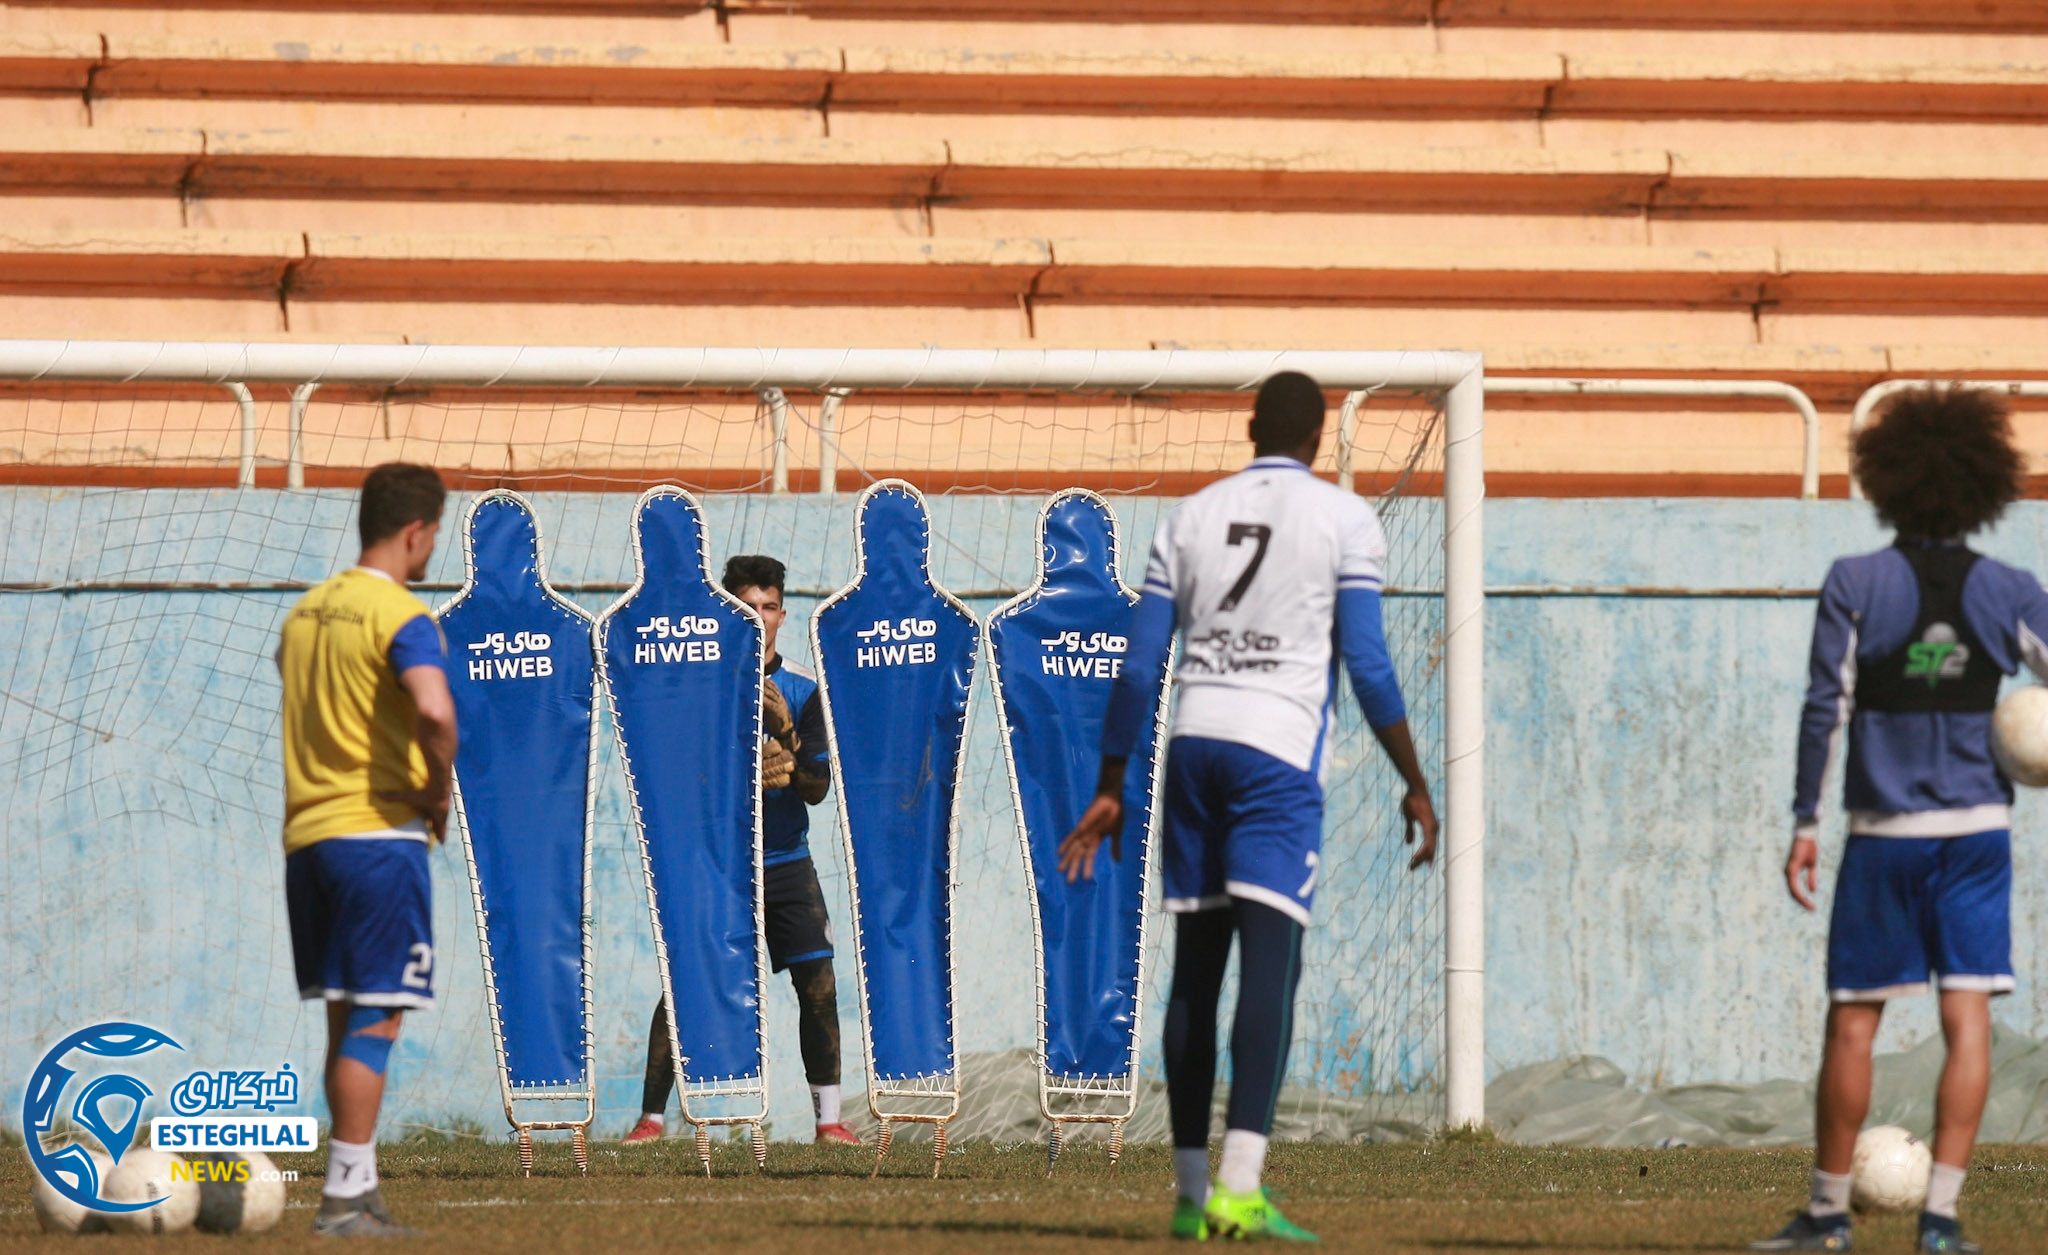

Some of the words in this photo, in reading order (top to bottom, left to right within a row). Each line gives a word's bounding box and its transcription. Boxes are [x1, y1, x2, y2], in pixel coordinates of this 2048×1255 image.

[1218, 522, 1272, 612] 7
[1904, 641, 1971, 684] ST2
[401, 942, 432, 989] 2
